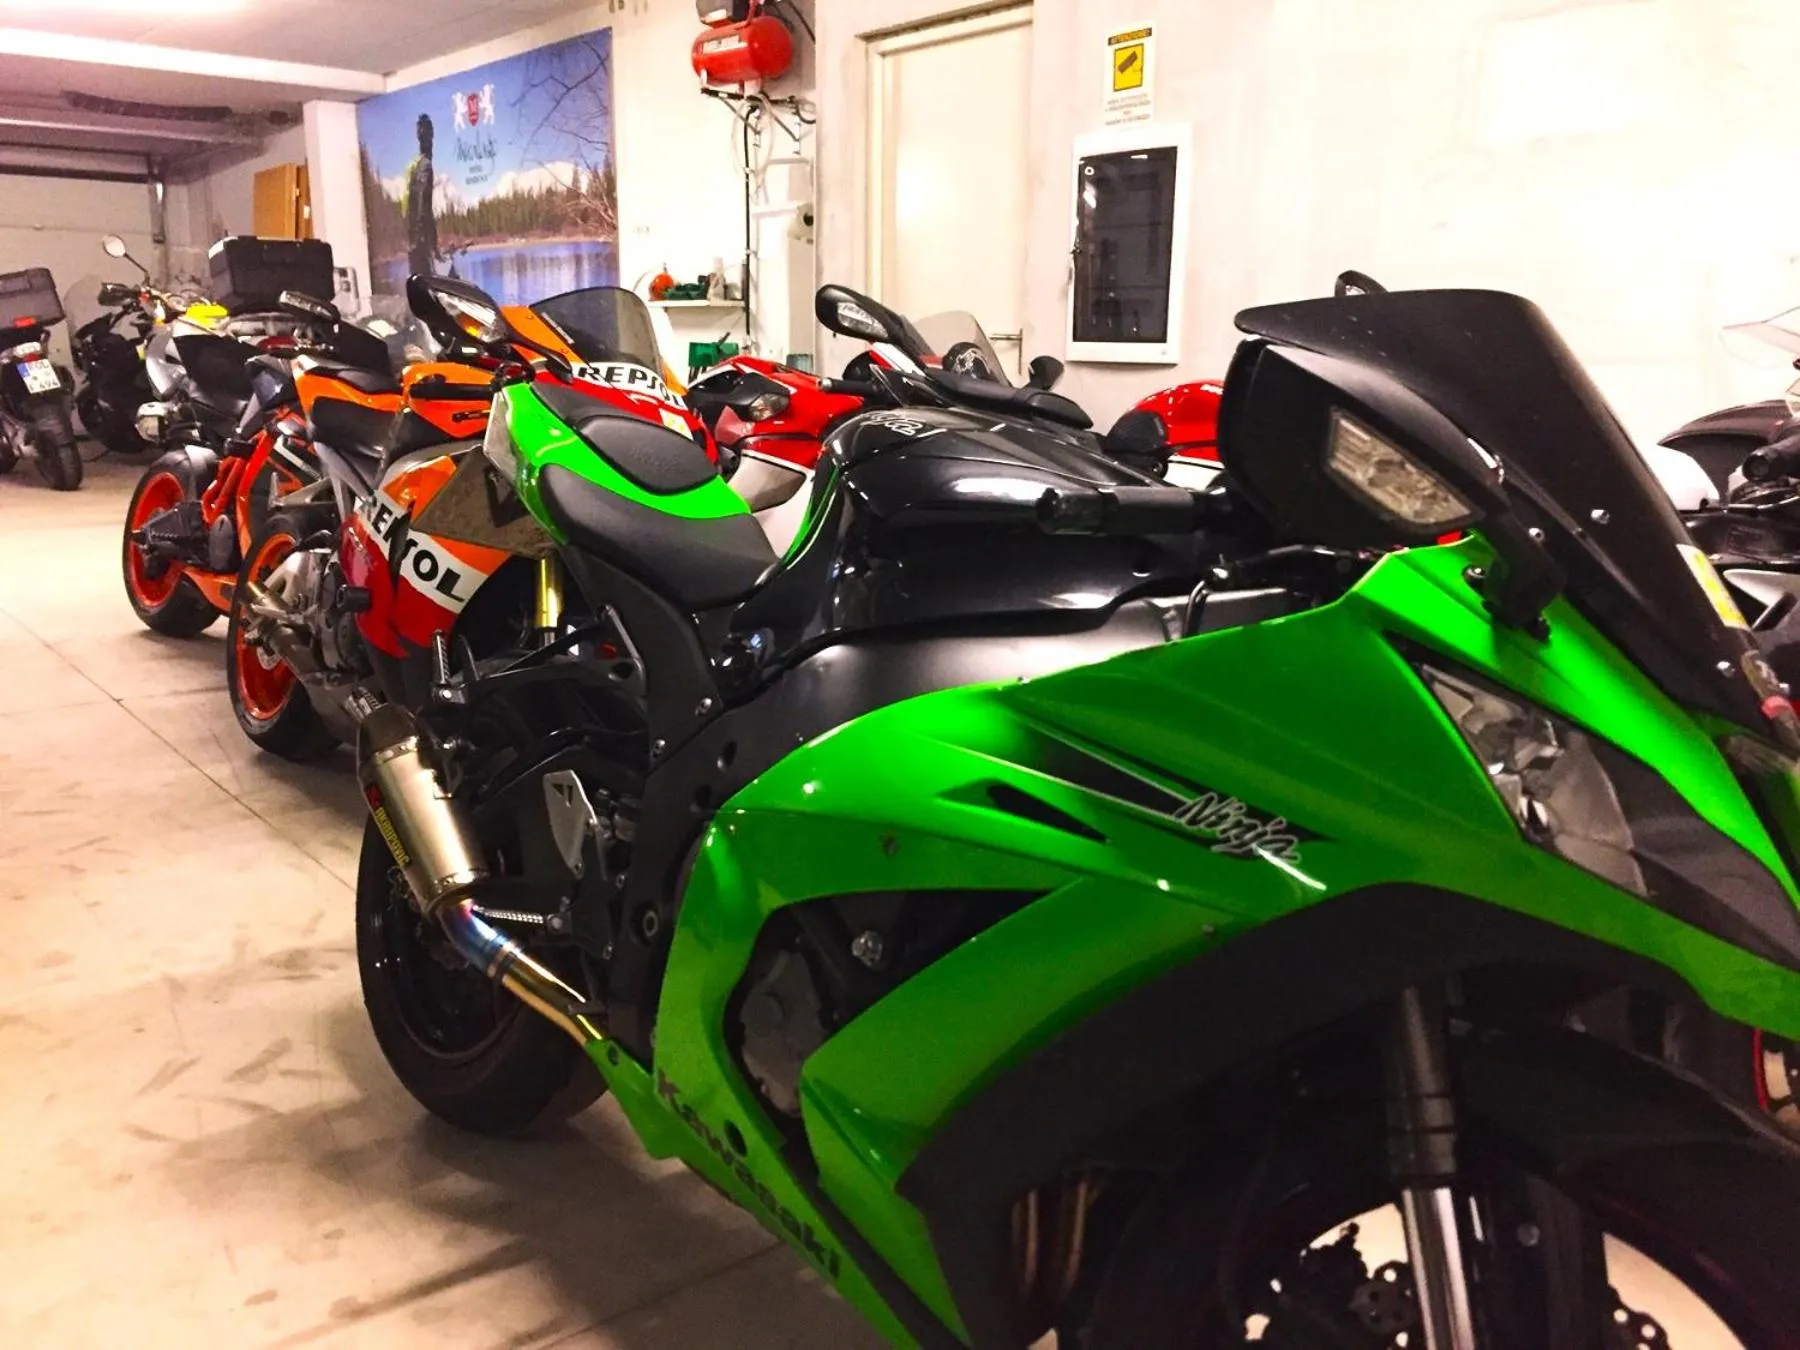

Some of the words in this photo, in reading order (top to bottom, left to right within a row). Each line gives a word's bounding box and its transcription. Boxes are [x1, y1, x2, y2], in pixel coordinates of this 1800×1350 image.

[578, 366, 684, 406] REPSOL
[1173, 792, 1302, 864] Ninja
[657, 1067, 840, 1279] Kawasaki
